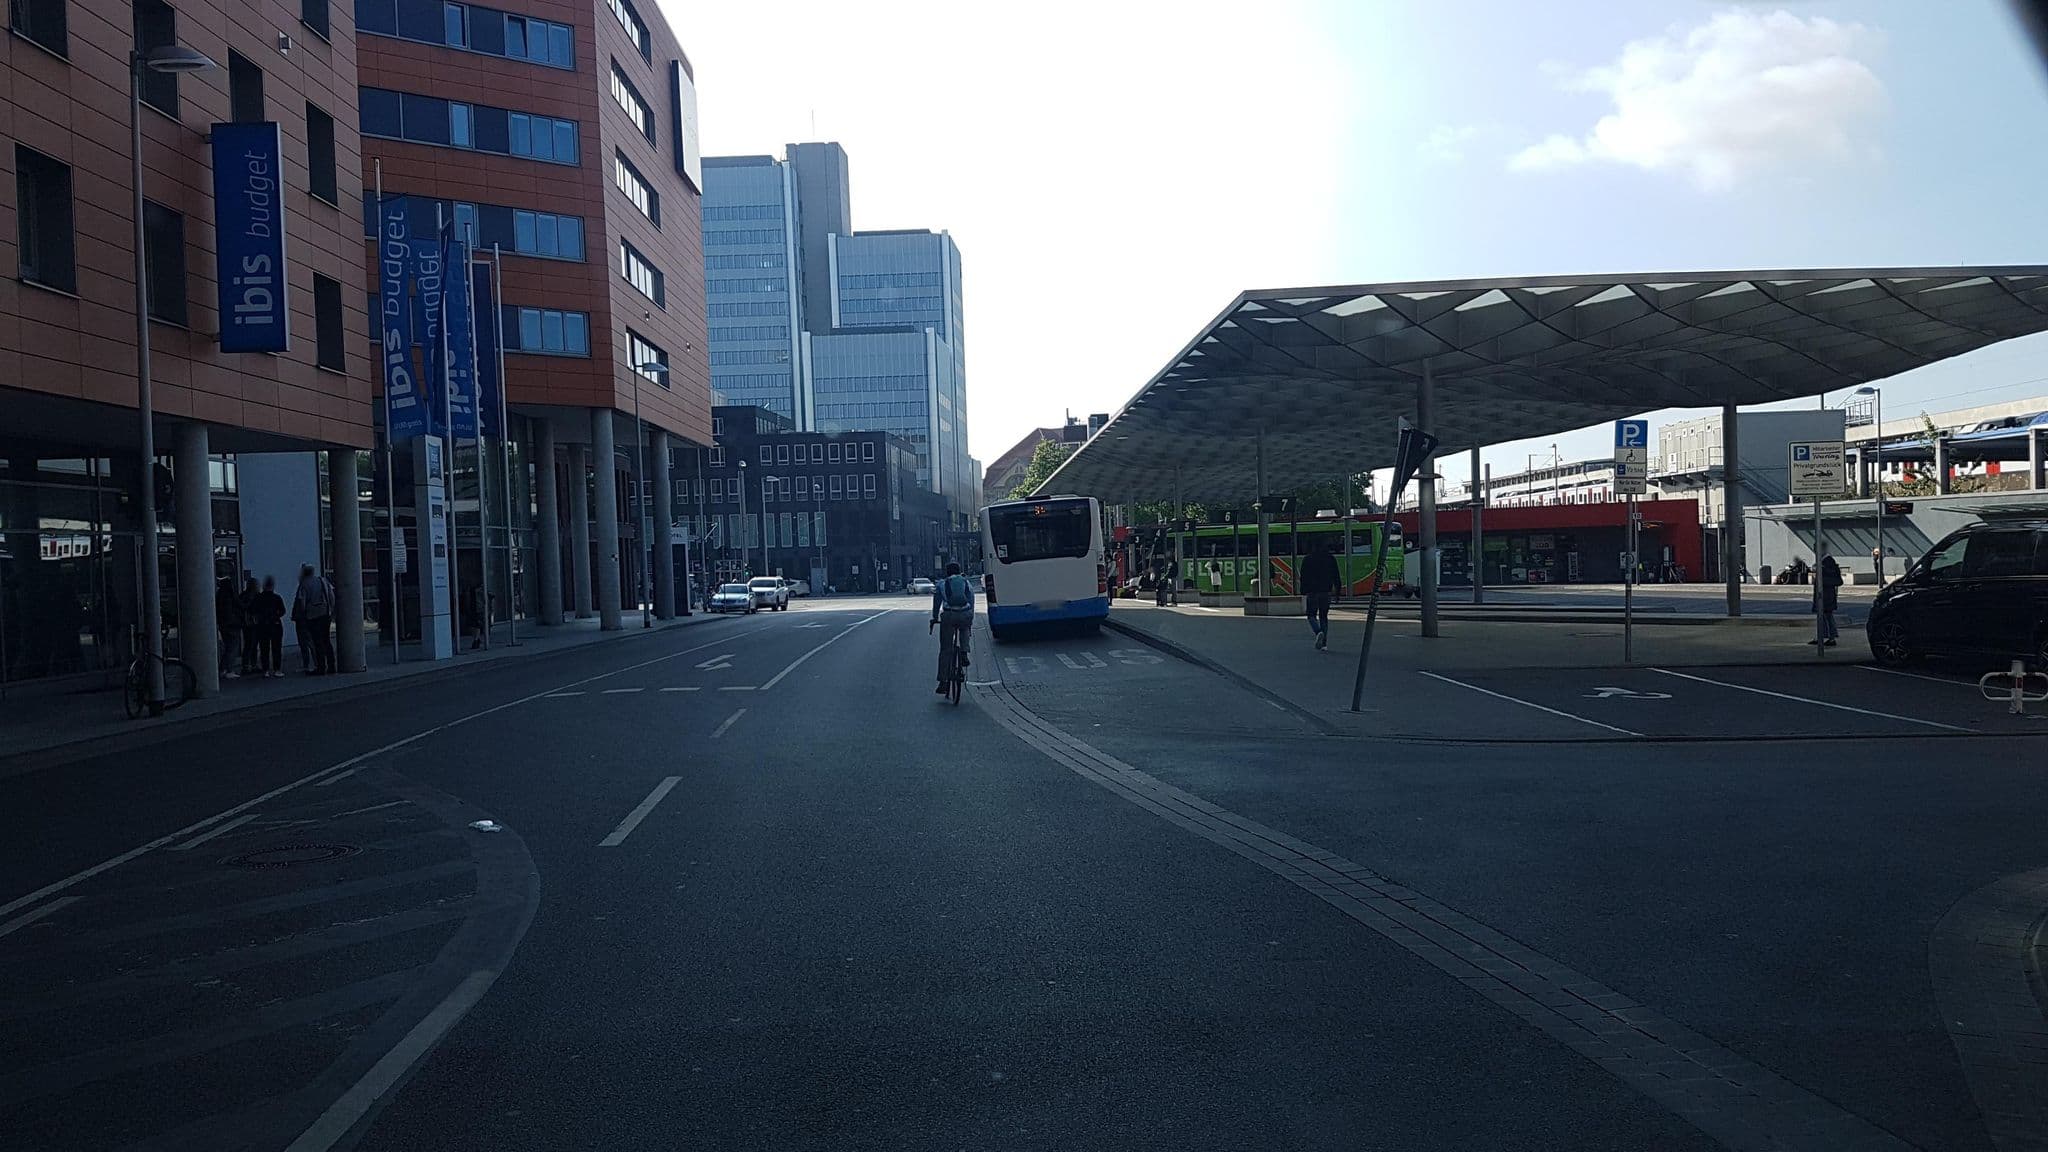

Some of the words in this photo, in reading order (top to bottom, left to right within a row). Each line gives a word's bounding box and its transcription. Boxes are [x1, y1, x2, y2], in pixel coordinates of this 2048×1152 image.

[243, 150, 275, 239] budget
[384, 210, 410, 317] budget
[233, 254, 274, 326] ibis
[386, 328, 417, 410] ibis
[1622, 423, 1641, 448] P
[1796, 446, 1807, 460] P
[1224, 511, 1231, 522] 6
[1281, 499, 1289, 511] 7
[1184, 521, 1190, 531] 5
[1004, 649, 1165, 674] BUS
